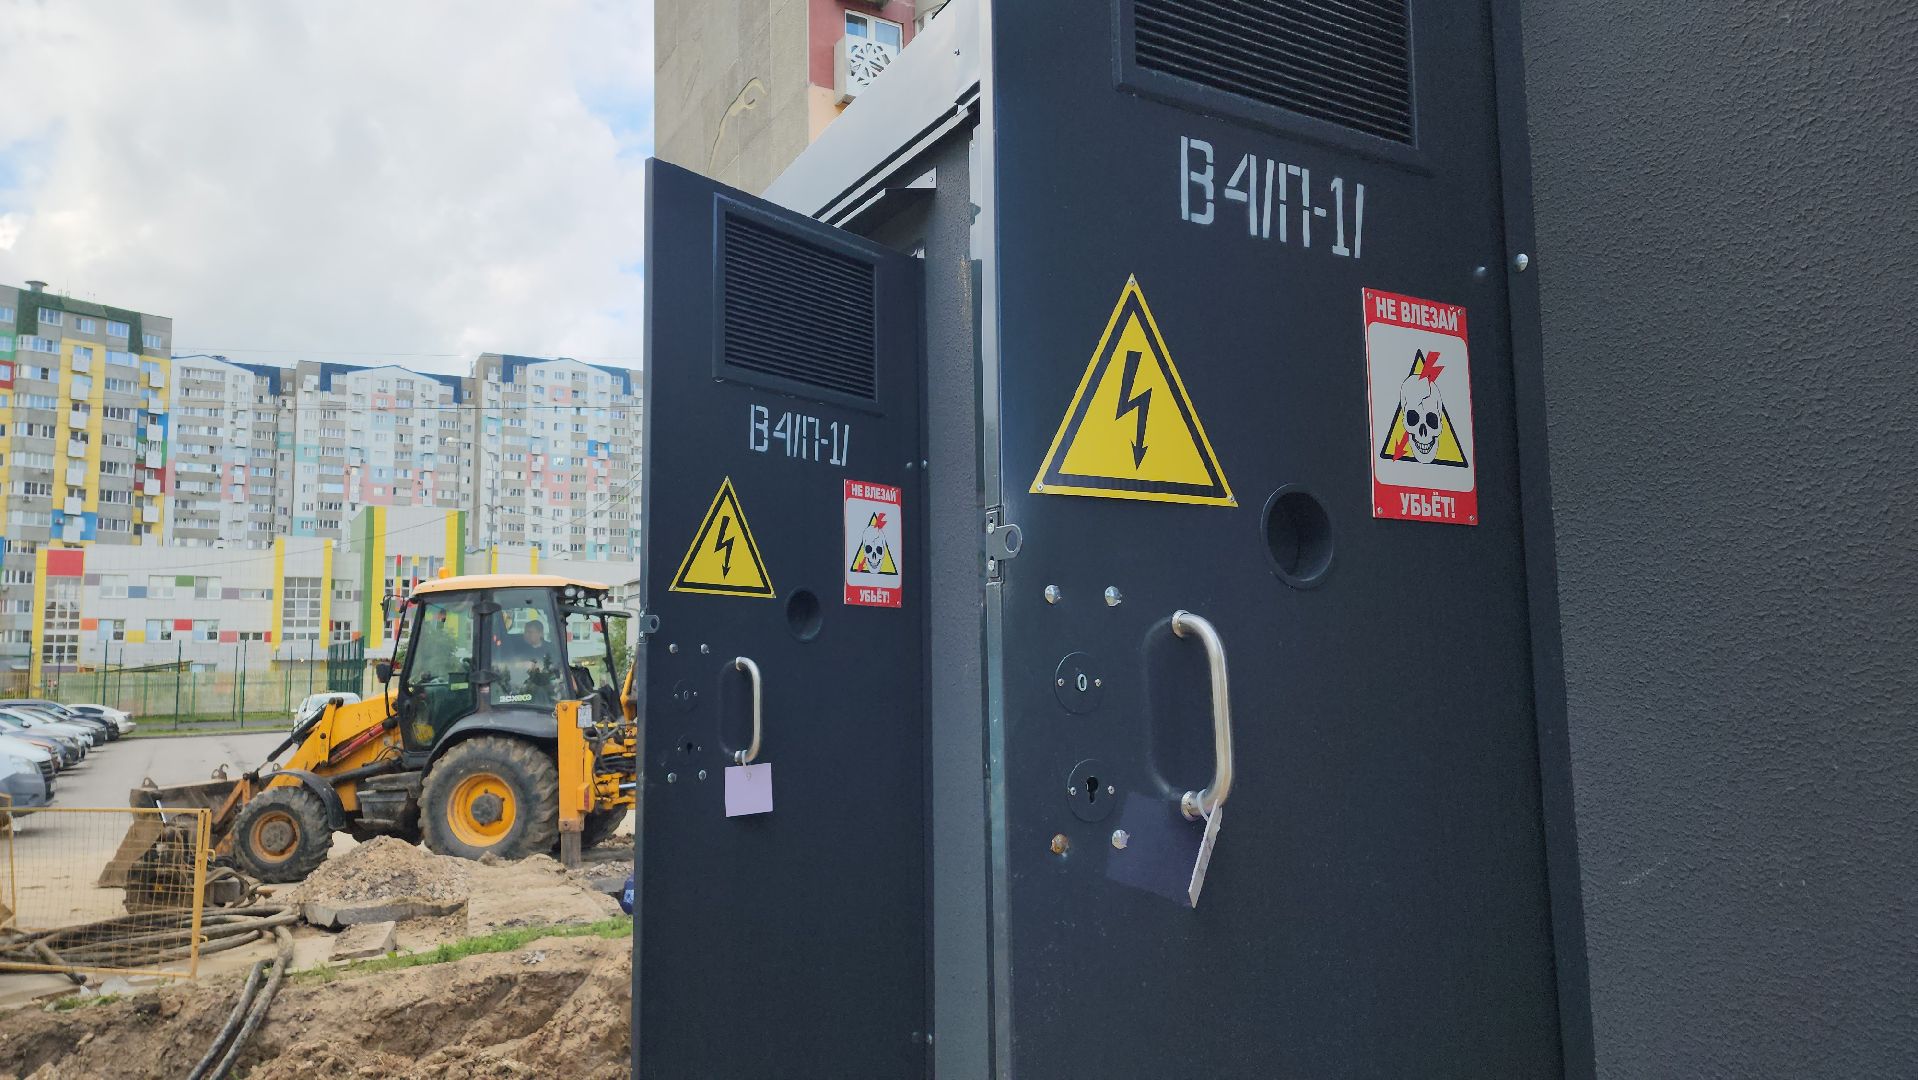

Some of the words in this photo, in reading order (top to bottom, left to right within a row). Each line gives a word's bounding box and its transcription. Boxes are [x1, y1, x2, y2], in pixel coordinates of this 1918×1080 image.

[1375, 296, 1397, 321] НЕ
[1401, 301, 1458, 332] ВЛЕЗАЙ
[851, 483, 863, 497] НЕ
[864, 487, 897, 503] ВЛЕЗАЙ
[1399, 491, 1456, 519] УБЬЁТ!
[859, 588, 890, 604] УБЬЁТ!
